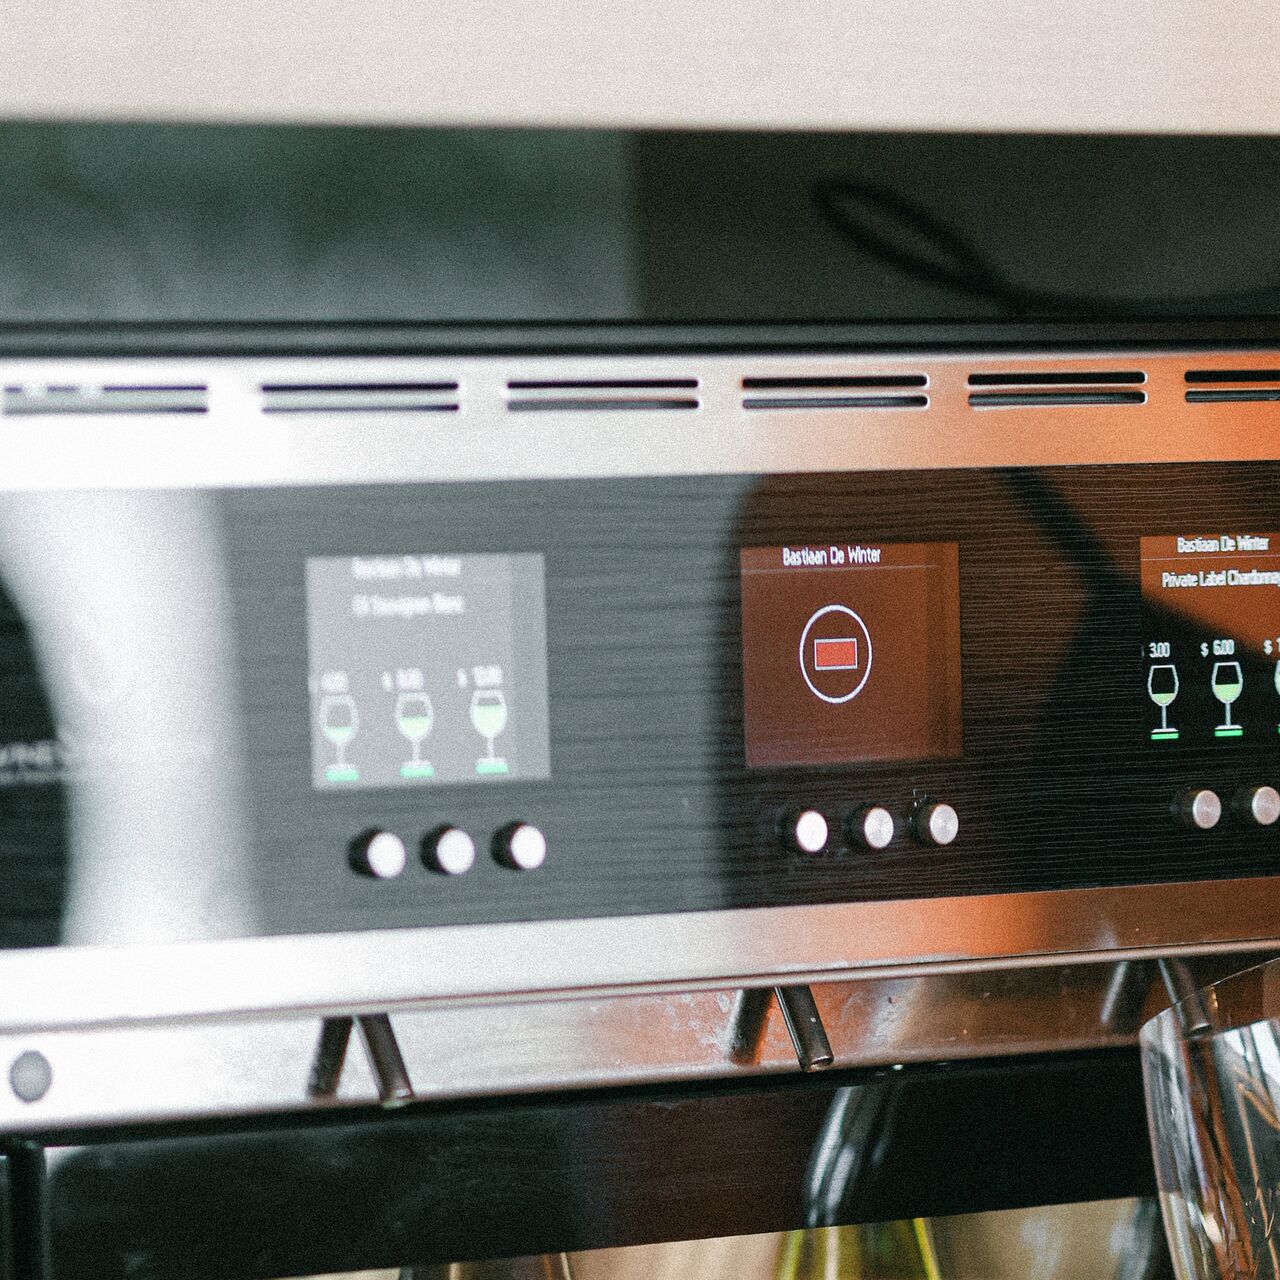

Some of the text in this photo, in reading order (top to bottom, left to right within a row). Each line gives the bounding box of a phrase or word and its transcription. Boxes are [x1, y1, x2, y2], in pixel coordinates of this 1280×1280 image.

[1177, 537, 1220, 553] Bastiaan
[1220, 535, 1236, 552] De
[783, 545, 881, 567] Bastiaan De Winter
[1162, 572, 1199, 588] Private
[1199, 570, 1227, 587] Label
[1149, 641, 1171, 658] 3.00
[1200, 642, 1209, 658] $
[1264, 639, 1273, 655] $
